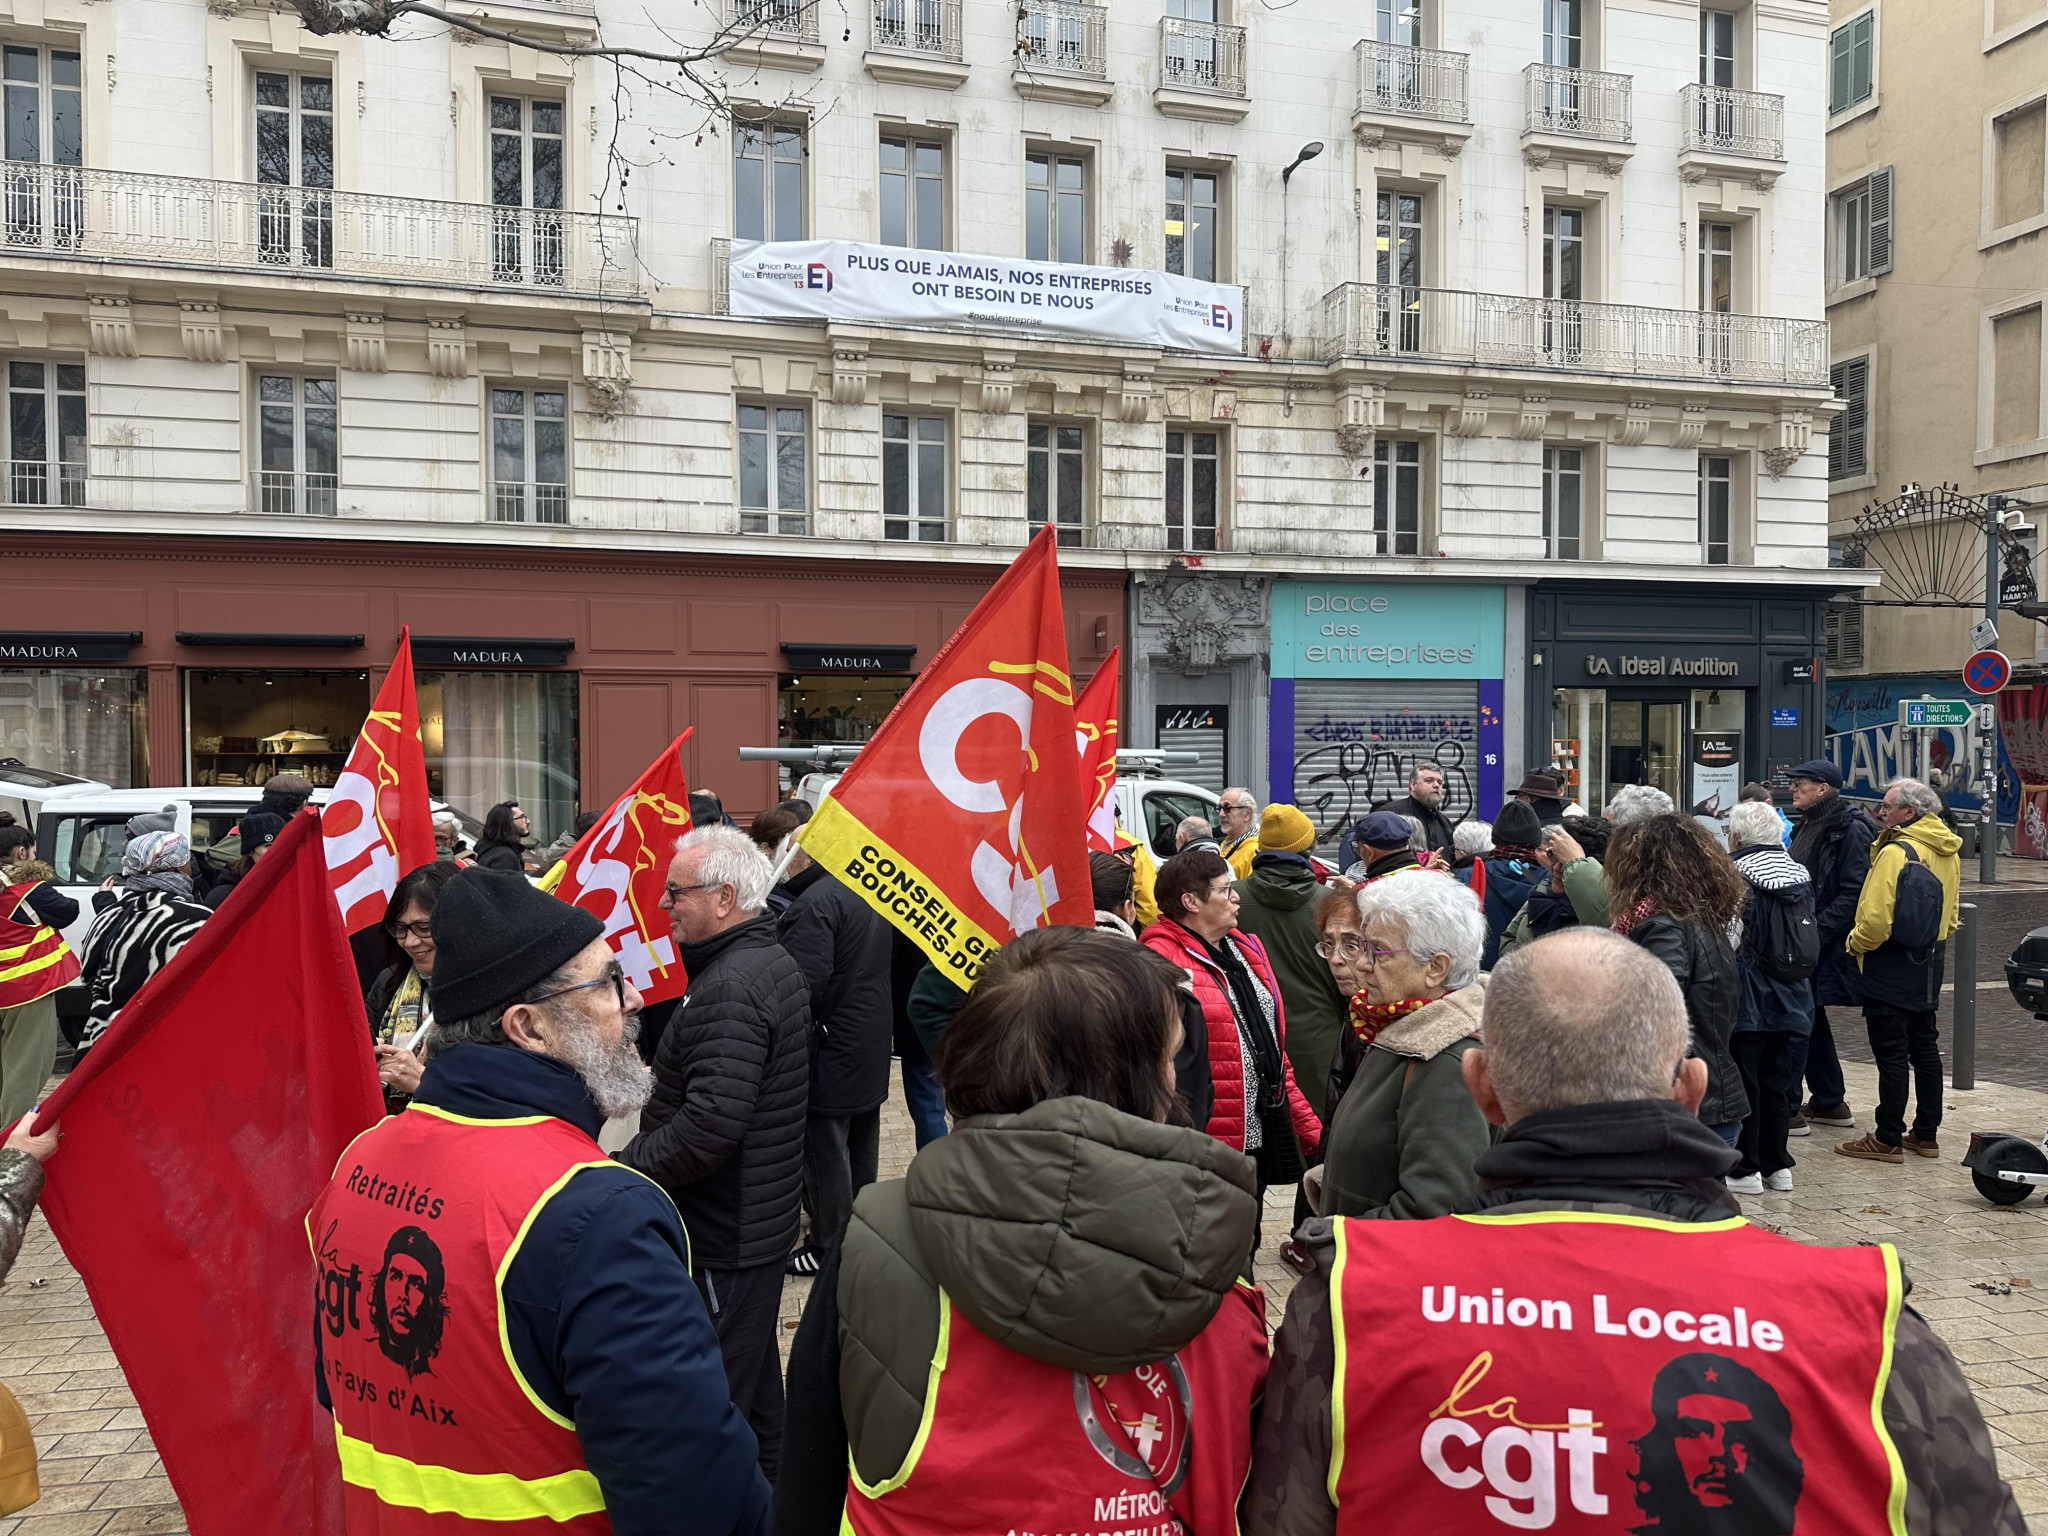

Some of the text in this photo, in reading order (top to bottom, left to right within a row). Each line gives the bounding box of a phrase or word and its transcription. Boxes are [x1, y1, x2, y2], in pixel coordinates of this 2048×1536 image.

[758, 262, 803, 271] Union Pour
[742, 271, 804, 282] les Entreprises
[848, 254, 1152, 296] PLUS QUE JAMAIS, NOS ENTREPRISES
[793, 280, 804, 289] 13
[912, 281, 1094, 310] ONT BESOIN DE NOUS
[1175, 296, 1209, 310] Union Pour
[1174, 304, 1210, 319] Entreprises
[1202, 318, 1210, 326] 13
[1305, 591, 1389, 616] place
[1320, 622, 1361, 637] des
[0, 646, 78, 658] MADURA
[453, 651, 523, 663] MADURA
[1306, 642, 1474, 667] entreprises
[821, 657, 882, 669] MADURA
[1619, 655, 1665, 676] Ideal
[1669, 656, 1738, 676] Audition
[1926, 704, 1951, 713] TOUTES
[1926, 714, 1964, 723] DIRECTIONS
[1484, 753, 1497, 765] 16
[861, 846, 957, 939] CONSEIL
[346, 1164, 445, 1220] Retraités
[319, 1218, 363, 1274] la
[1421, 1285, 1784, 1352] Union Locale
[335, 1358, 378, 1403] Pays
[388, 1386, 458, 1427] d'Aix
[1428, 1350, 1603, 1430] la
[1420, 1408, 1608, 1530] cgt
